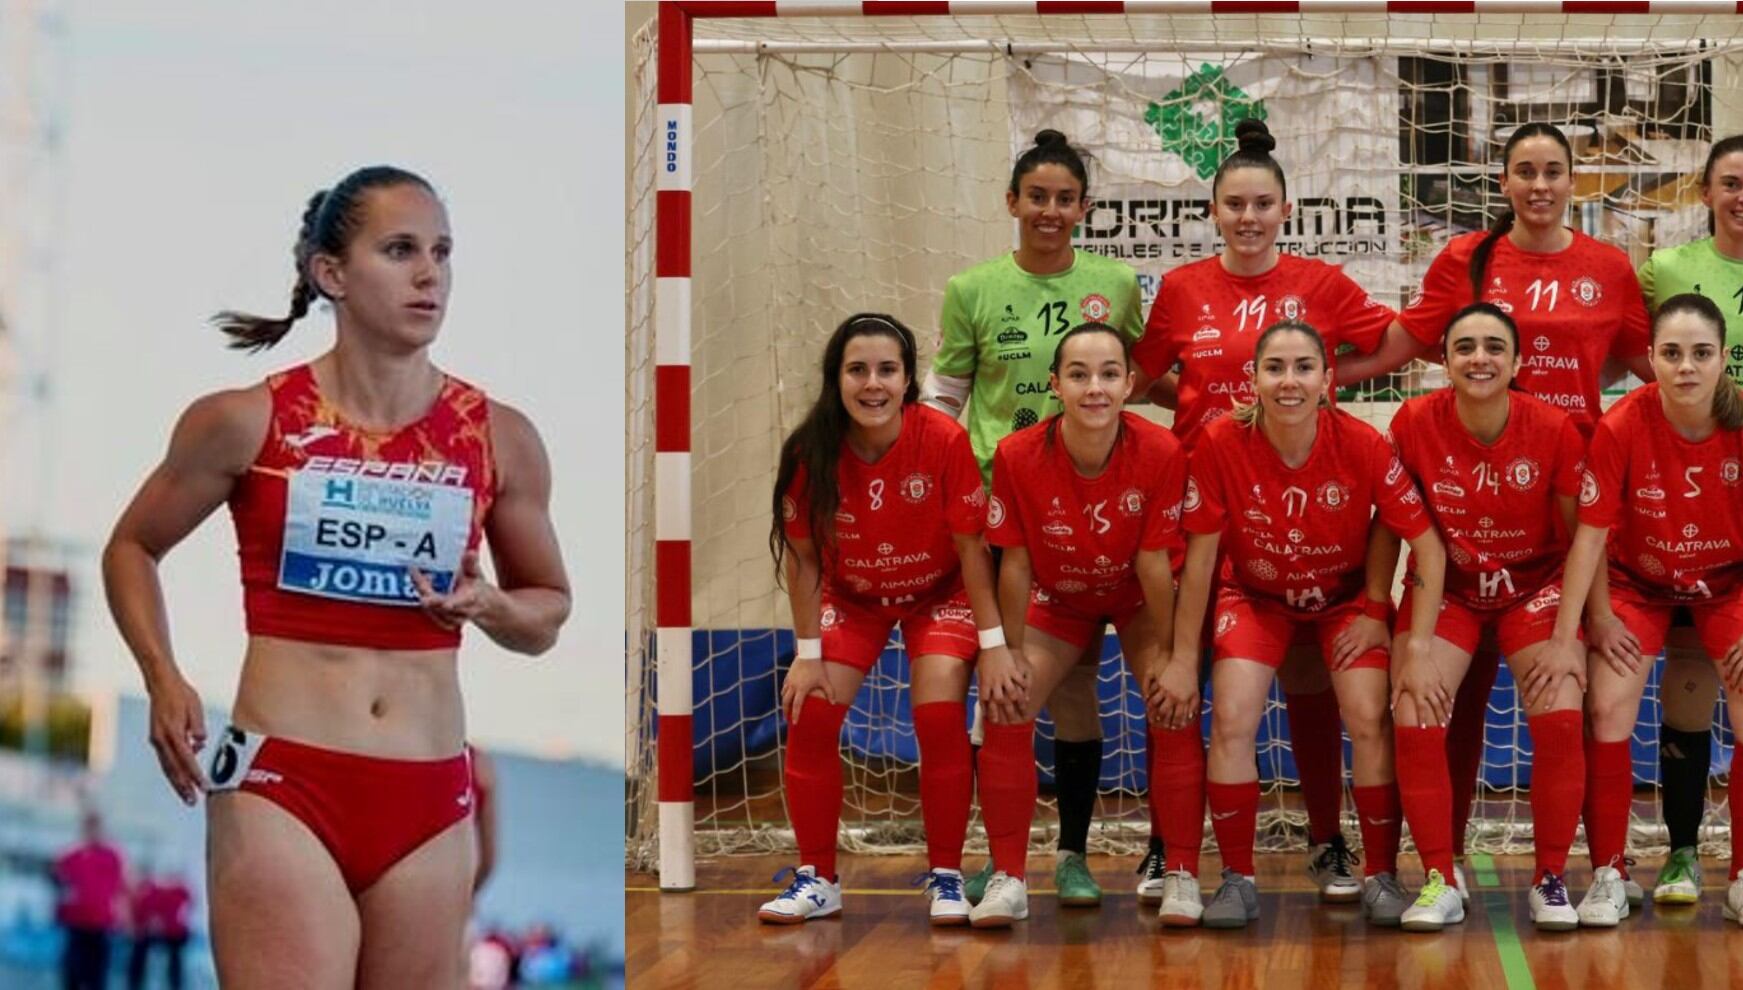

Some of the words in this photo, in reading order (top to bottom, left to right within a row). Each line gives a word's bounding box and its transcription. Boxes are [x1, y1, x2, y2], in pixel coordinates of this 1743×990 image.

[666, 120, 678, 172] MONDO
[1172, 243, 1203, 257] DE
[1525, 279, 1560, 312] 11
[1036, 300, 1071, 337] 13
[1232, 294, 1268, 332] 19
[1519, 355, 1580, 370] LATRAVA
[868, 479, 885, 511] 8
[1471, 461, 1500, 496] 14
[1683, 466, 1704, 498] 5
[1082, 499, 1112, 535] 15
[316, 518, 386, 549] ESP
[413, 532, 438, 560] A
[1645, 535, 1732, 553] CALATRAVA
[844, 551, 932, 569] CALATRAVA
